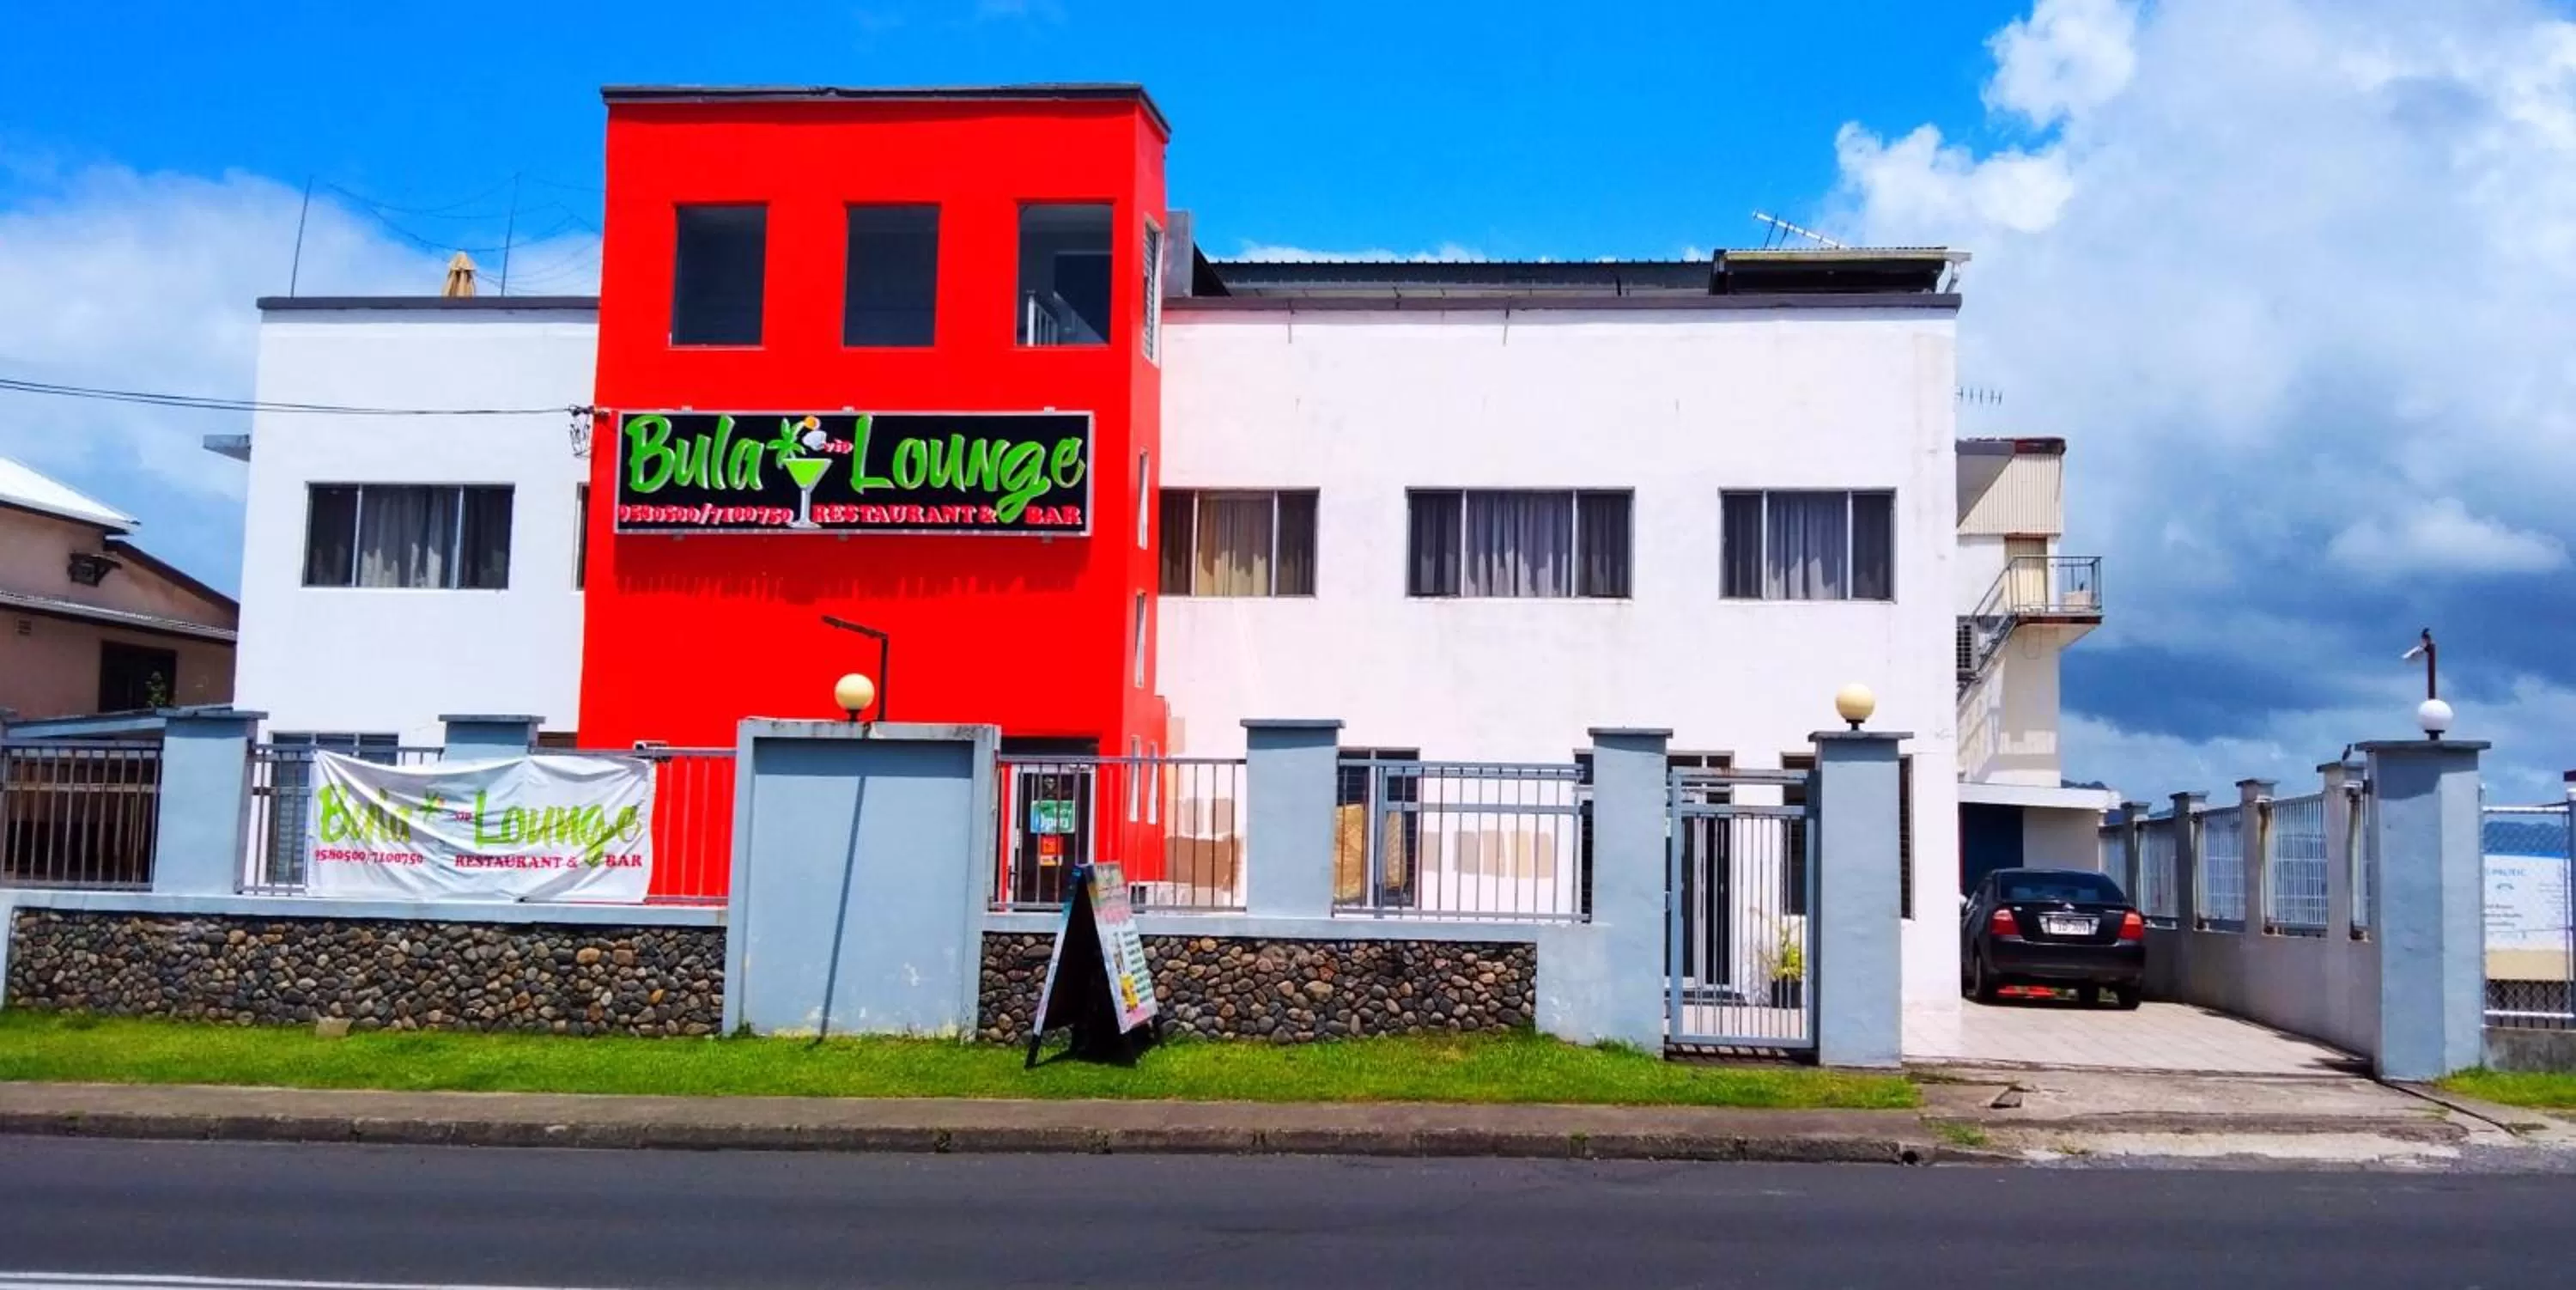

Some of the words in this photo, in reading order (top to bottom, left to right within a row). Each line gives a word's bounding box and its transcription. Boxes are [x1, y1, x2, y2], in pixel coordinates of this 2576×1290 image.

[625, 414, 764, 493] Bula
[850, 413, 1085, 524] Lounge
[811, 504, 977, 524] RESTAURANT
[977, 505, 999, 524] &
[1024, 505, 1083, 525] BAR
[475, 789, 642, 867] Lounge
[454, 855, 564, 867] RESTAURANT
[566, 855, 578, 867] &
[605, 855, 642, 867] BAR
